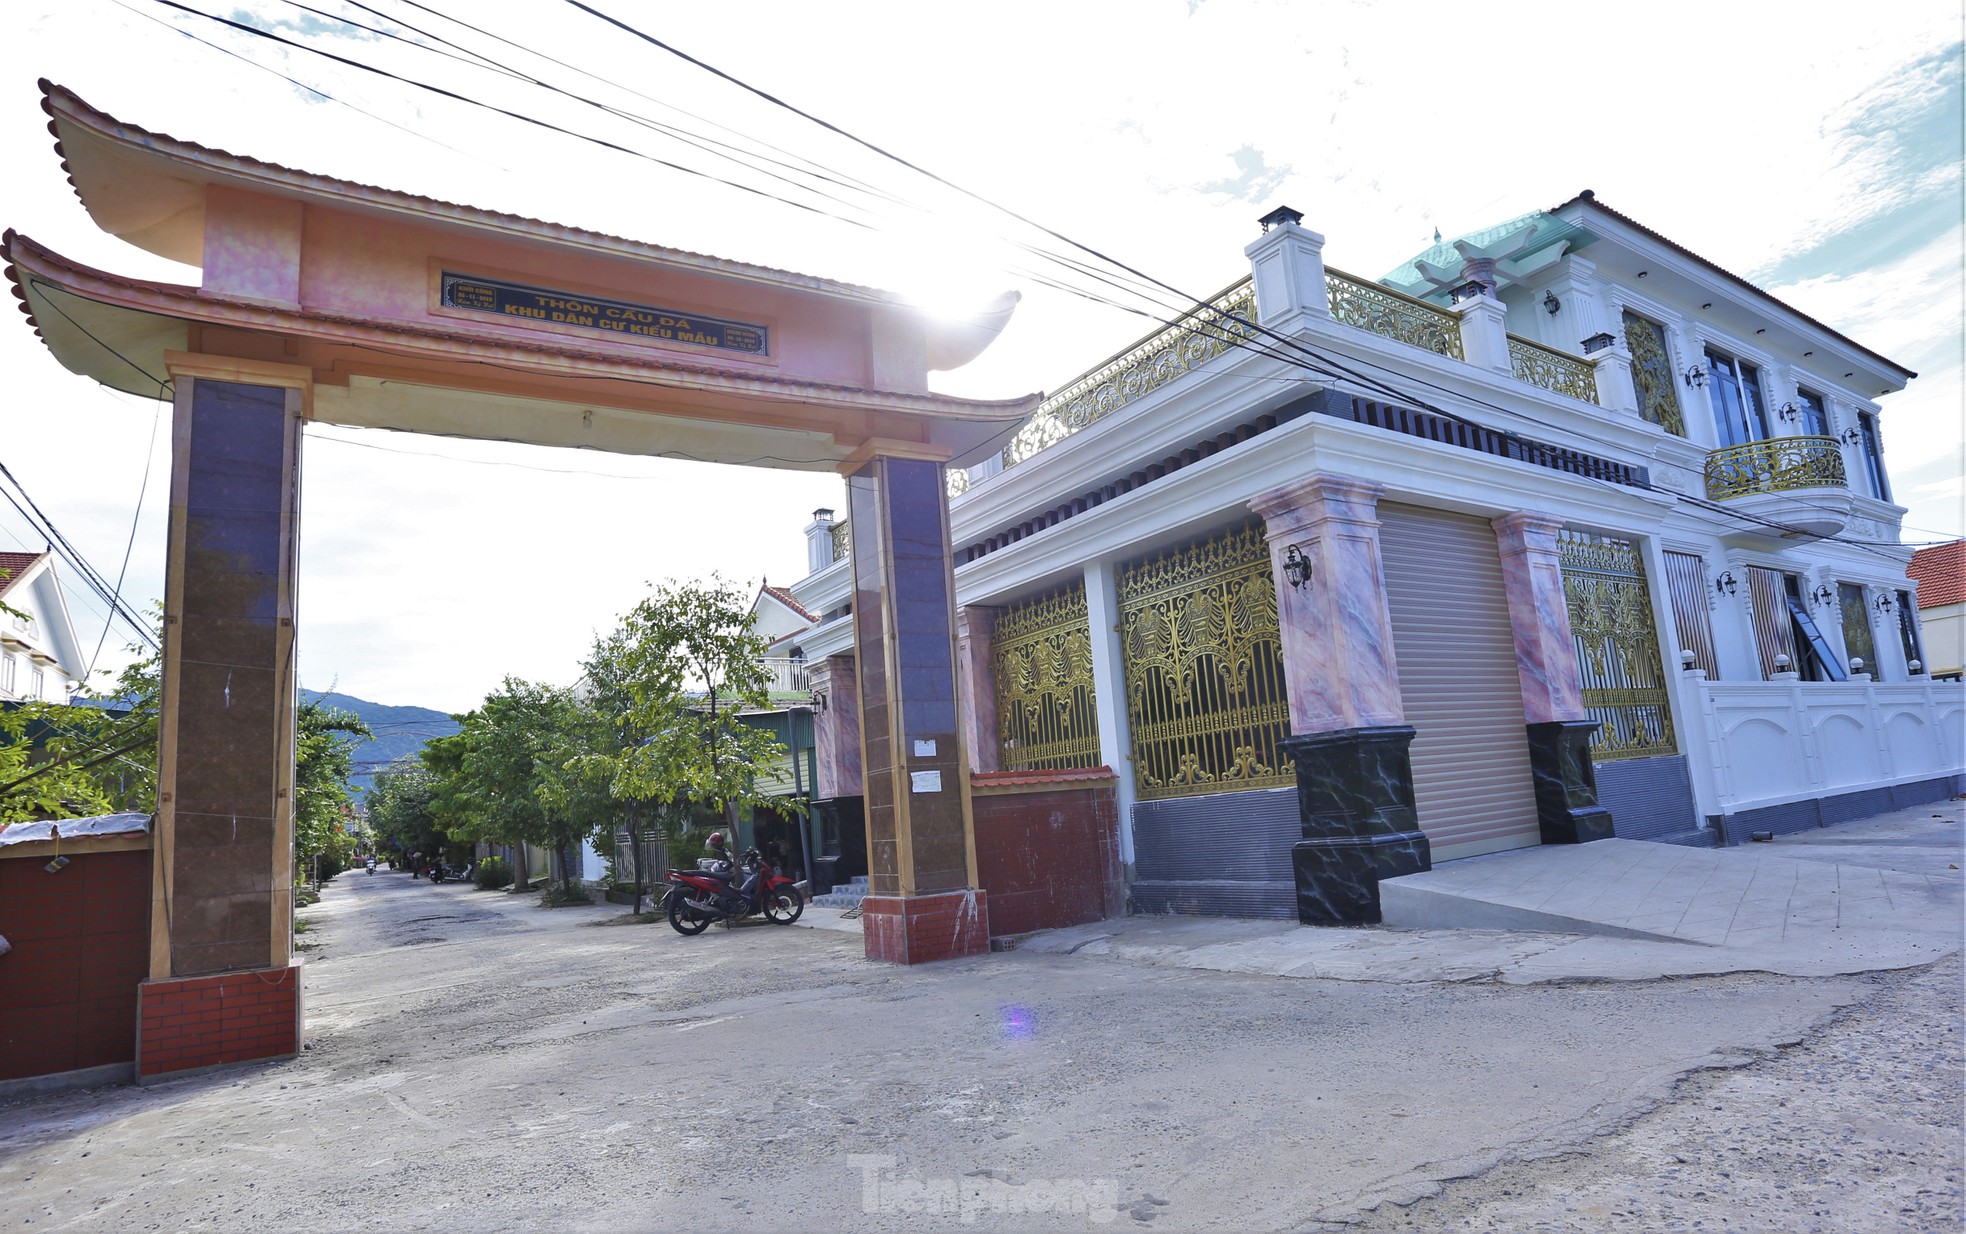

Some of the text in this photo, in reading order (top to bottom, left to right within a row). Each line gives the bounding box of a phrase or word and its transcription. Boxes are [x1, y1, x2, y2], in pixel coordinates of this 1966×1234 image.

[504, 304, 546, 319] KHU
[552, 312, 593, 327] DÂN
[599, 319, 627, 331] CƯ
[535, 296, 599, 314] THÔN
[658, 316, 690, 330] ĐÁ
